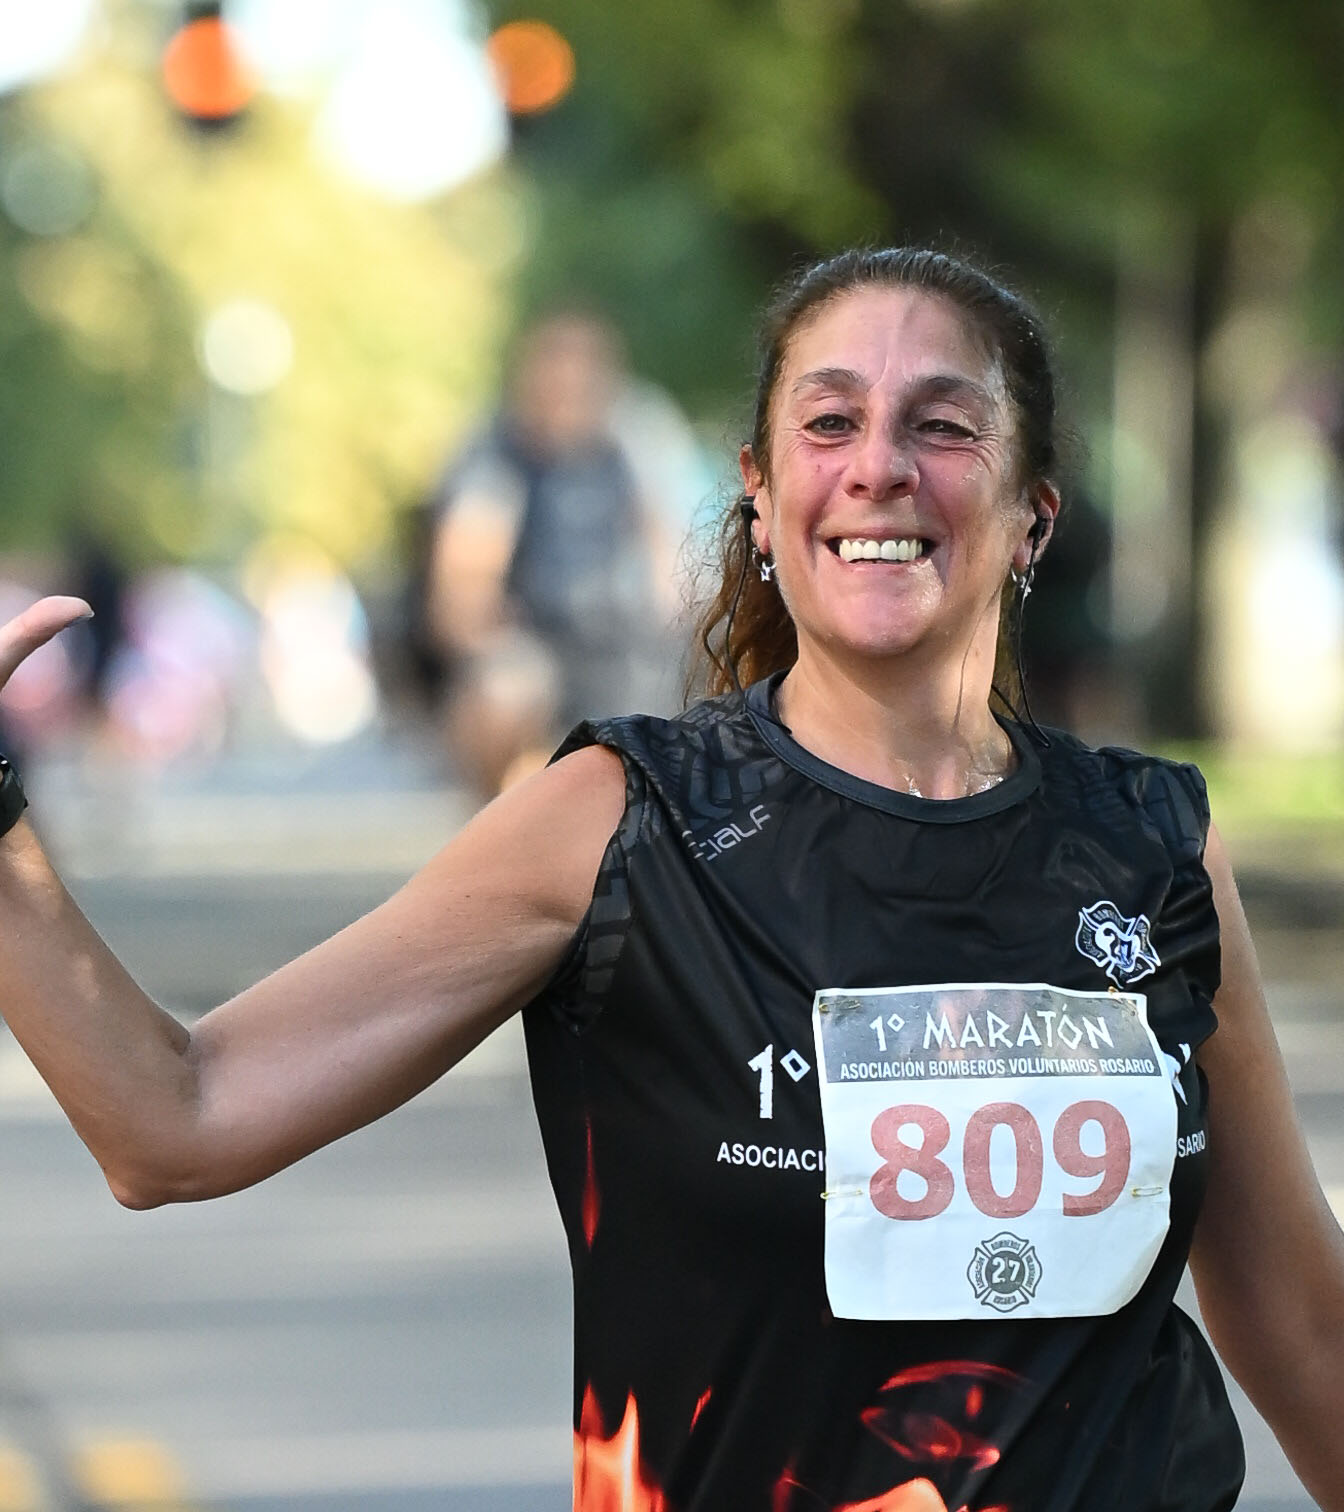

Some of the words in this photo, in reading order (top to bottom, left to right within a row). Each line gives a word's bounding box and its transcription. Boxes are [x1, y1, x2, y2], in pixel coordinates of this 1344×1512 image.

[923, 1003, 1115, 1050] MARATÓN
[840, 1057, 925, 1080] ASOCIACIÓN
[928, 1057, 1006, 1076] BOMBEROS
[1008, 1057, 1098, 1075] VOLUNTARIOS
[1098, 1057, 1155, 1074] ROSARIO
[717, 1141, 825, 1172] ASOCIACI
[1177, 1129, 1206, 1158] SARIO
[869, 1099, 1132, 1221] 809
[992, 1256, 1021, 1284] 27
